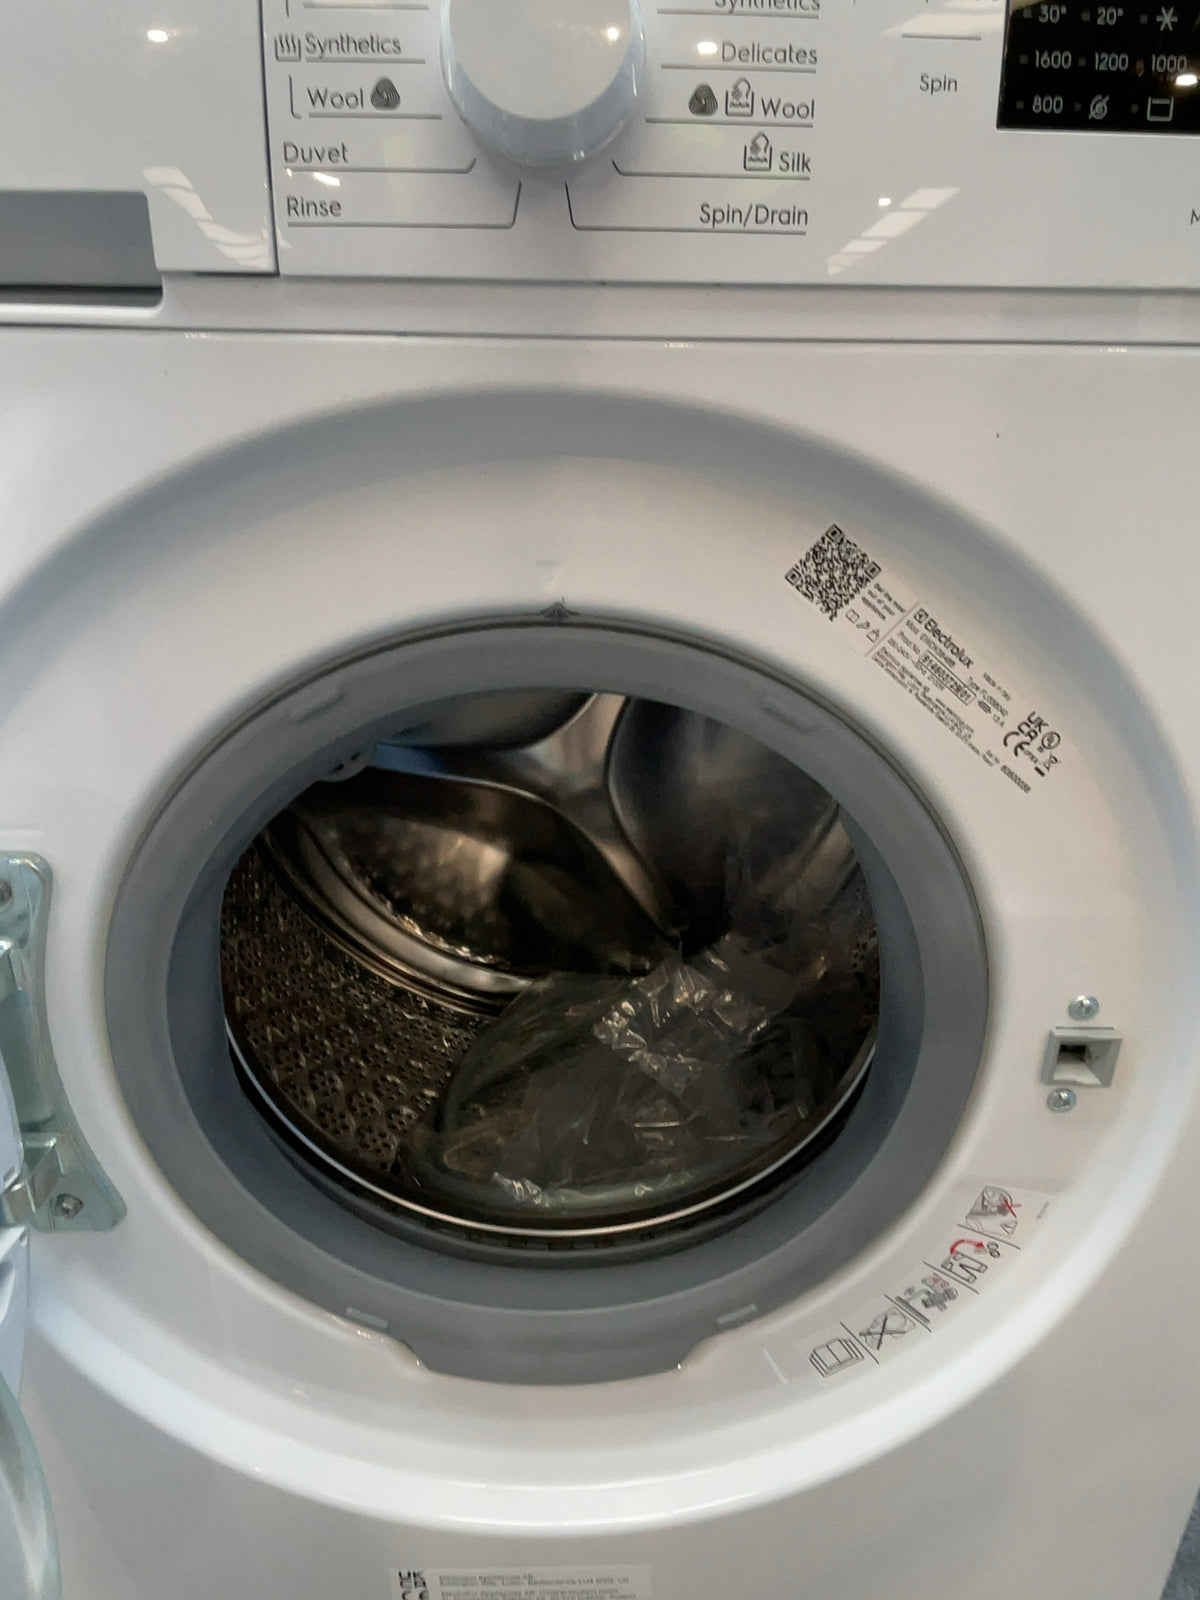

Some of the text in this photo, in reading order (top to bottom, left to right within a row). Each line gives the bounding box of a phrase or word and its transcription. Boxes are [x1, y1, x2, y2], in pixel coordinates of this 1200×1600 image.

[1038, 5, 1124, 25] 30° 20°
[305, 32, 402, 59] Synthetics
[721, 40, 818, 65] Delicates
[1035, 50, 1188, 73] 1600 1200 1000
[919, 73, 958, 96] Spin
[307, 87, 364, 109] Wool
[761, 96, 815, 119] Wool
[1032, 94, 1063, 114] 800
[283, 141, 349, 163] Duvet
[779, 151, 811, 172] Silk
[286, 195, 342, 217] Rinse
[699, 202, 808, 229] Spin/Drain
[924, 617, 975, 669] Electrolux
[1018, 721, 1038, 742] CA
[1027, 710, 1049, 733] UK
[1003, 731, 1030, 757] CE
